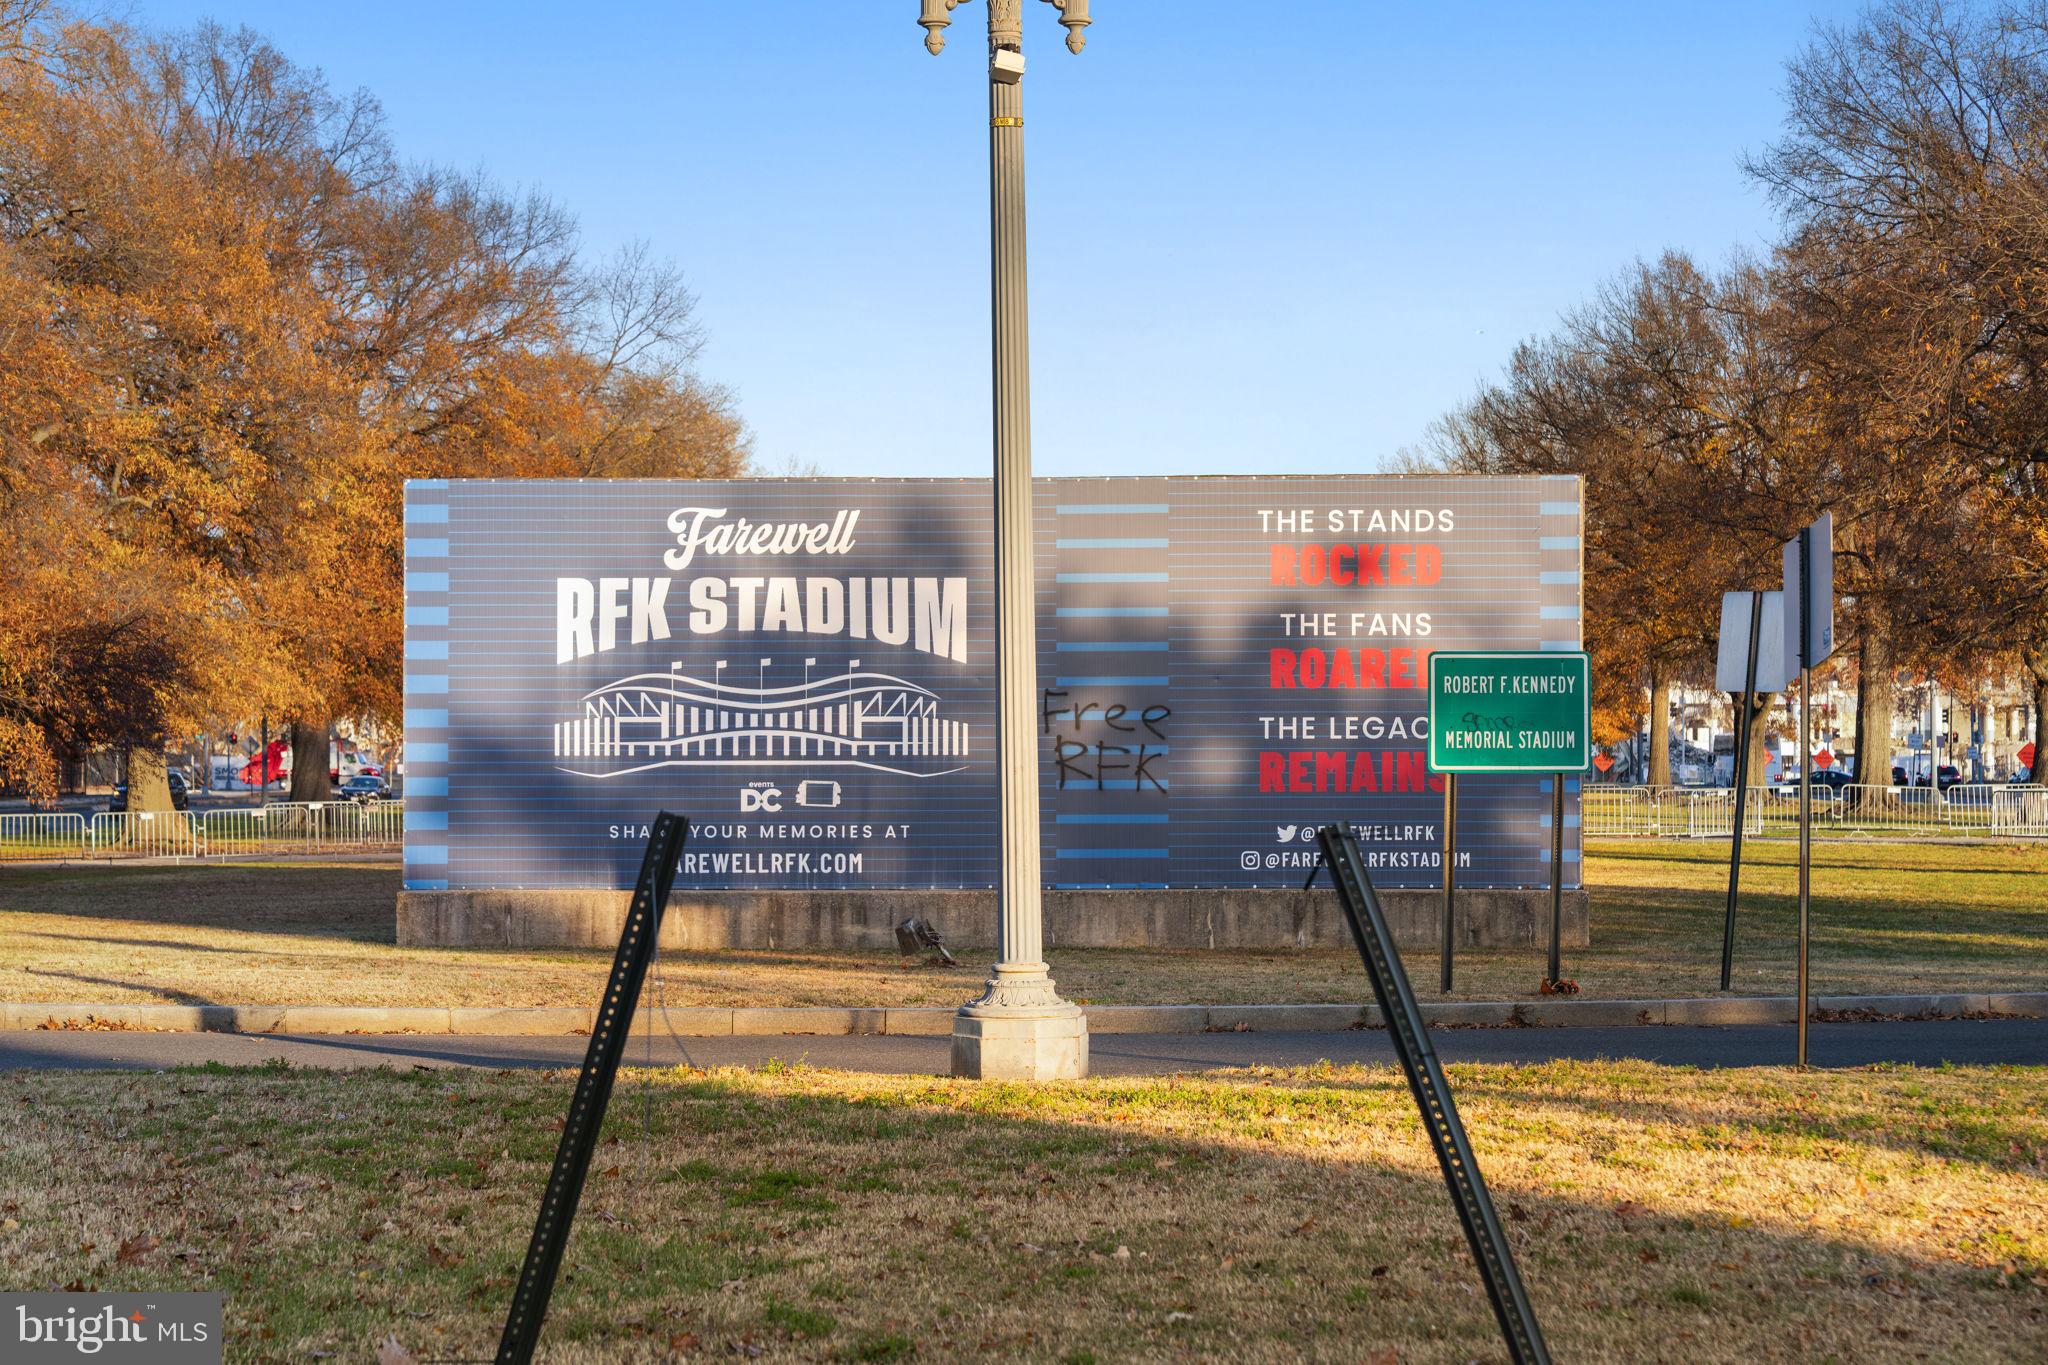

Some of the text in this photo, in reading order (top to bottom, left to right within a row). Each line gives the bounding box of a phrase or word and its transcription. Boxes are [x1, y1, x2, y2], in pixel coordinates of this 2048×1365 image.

[1257, 509, 1455, 533] THE STANDS
[664, 507, 860, 570] Farewell
[1269, 544, 1443, 586] ROCKED
[557, 576, 968, 665] RFK STADIUM
[1280, 613, 1433, 636] THE FANS
[1443, 675, 1495, 694] ROBERT
[1042, 688, 1171, 740] Free
[1258, 716, 1429, 740] THE LEGAC
[1445, 730, 1576, 749] MEMORIAL STADIUM
[1055, 735, 1168, 794] RFK
[740, 788, 783, 812] DC
[609, 825, 911, 839] SHA YOUR MEMORIES AT
